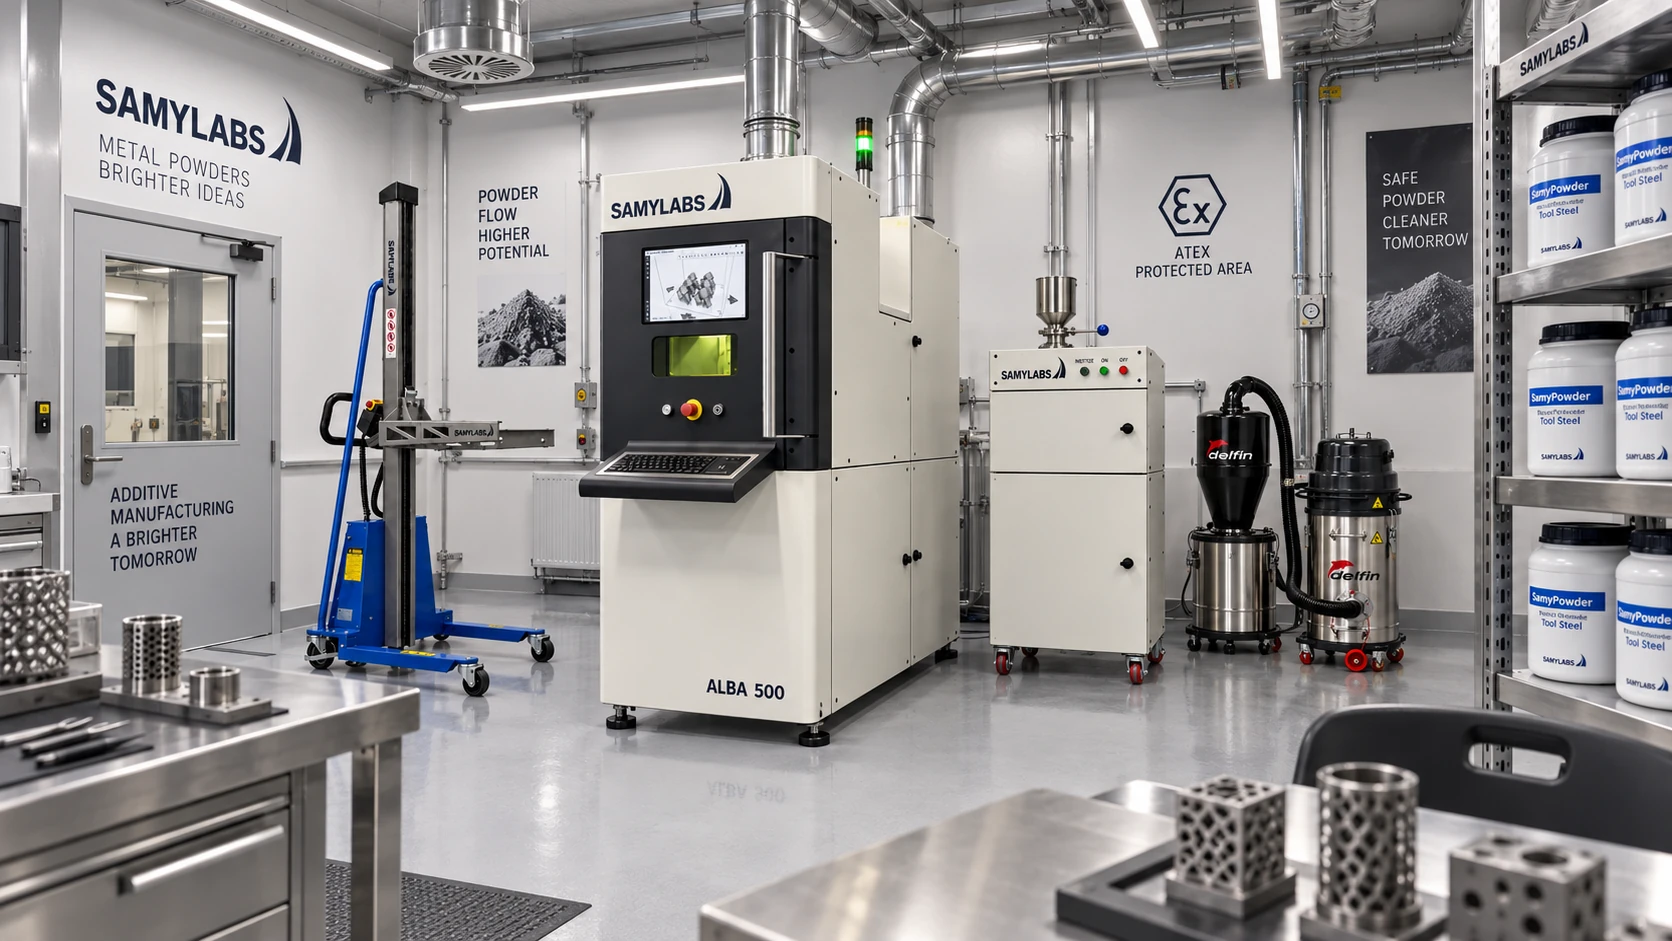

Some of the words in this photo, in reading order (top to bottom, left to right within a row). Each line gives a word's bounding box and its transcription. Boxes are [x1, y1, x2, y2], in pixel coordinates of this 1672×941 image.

[1520, 35, 1576, 77] SAMYLABS
[96, 78, 266, 155] SAMYLABS
[99, 133, 161, 167] METAL
[169, 151, 250, 188] POWDERS
[99, 159, 190, 197] BRIGHTER
[198, 182, 245, 209] IDEAS
[1382, 170, 1419, 187] SAFE
[1638, 172, 1663, 186] Steel
[478, 185, 539, 204] POWDER
[1382, 190, 1446, 208] POWDER
[478, 207, 518, 223] FLOW
[610, 194, 706, 220] SAMYLABS
[1539, 209, 1555, 219] Tool
[1555, 206, 1579, 217] Steel
[1382, 212, 1448, 229] CLEANER
[478, 226, 531, 243] HIGHER
[1382, 232, 1469, 250] TOMORROW
[478, 243, 550, 261] POTENTIAL
[1174, 245, 1211, 260] ATEX
[1135, 263, 1213, 278] PROTECTED
[1216, 261, 1253, 276] AREA
[1001, 369, 1052, 380] SAMYLABS
[1531, 391, 1592, 405] SamyPowder
[1618, 382, 1672, 398] SamyPowde
[1540, 416, 1555, 425] Tool
[1557, 416, 1581, 425] Steel
[1625, 411, 1638, 421] Tool
[1640, 410, 1663, 421] Steel
[1208, 450, 1253, 460] delfin
[110, 483, 179, 503] ADDITIVE
[110, 500, 235, 525] MANUFACTURING
[110, 532, 121, 549] A
[126, 525, 198, 548] BRIGHTER
[110, 546, 198, 572] TOMORROW
[1330, 571, 1380, 581] delfin
[1531, 591, 1593, 608] SamyPowder
[1618, 606, 1672, 625] SamyPowde
[1541, 618, 1557, 628] Tool
[1559, 620, 1583, 631] Steel
[1626, 636, 1639, 647] Tool
[1641, 639, 1665, 652] Steel
[706, 678, 748, 697] ALBA
[754, 683, 785, 700] 500
